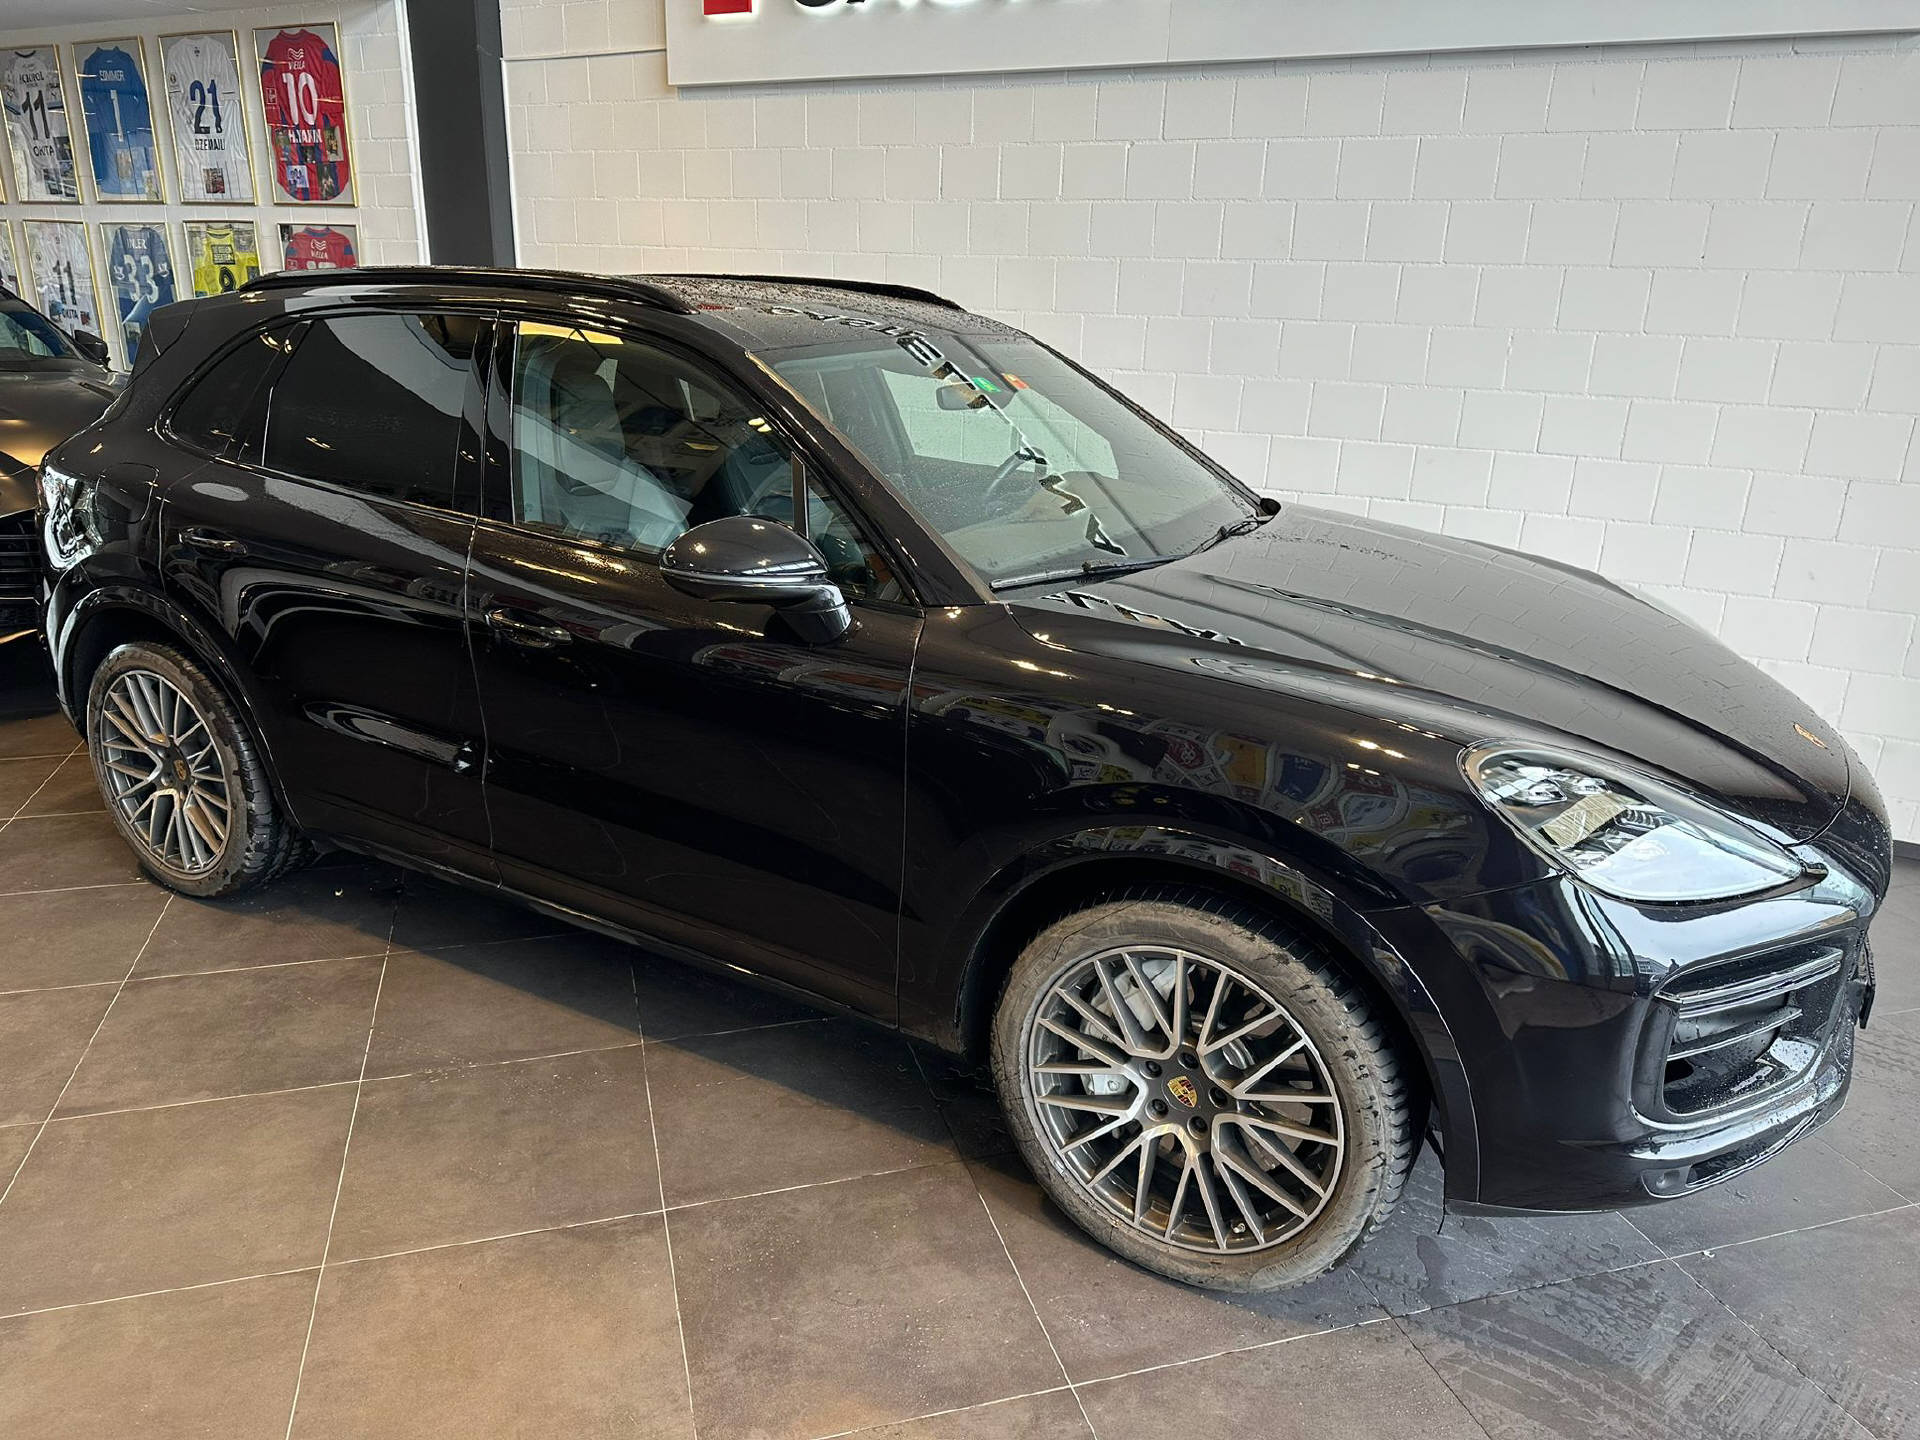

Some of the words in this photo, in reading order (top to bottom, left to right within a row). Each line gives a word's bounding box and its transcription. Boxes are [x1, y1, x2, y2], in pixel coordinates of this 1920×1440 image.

[99, 70, 125, 82] SOMMER
[282, 72, 318, 126] 10
[22, 90, 50, 140] 11
[190, 79, 222, 134] 21
[53, 260, 77, 305] 11
[123, 254, 159, 304] 33
